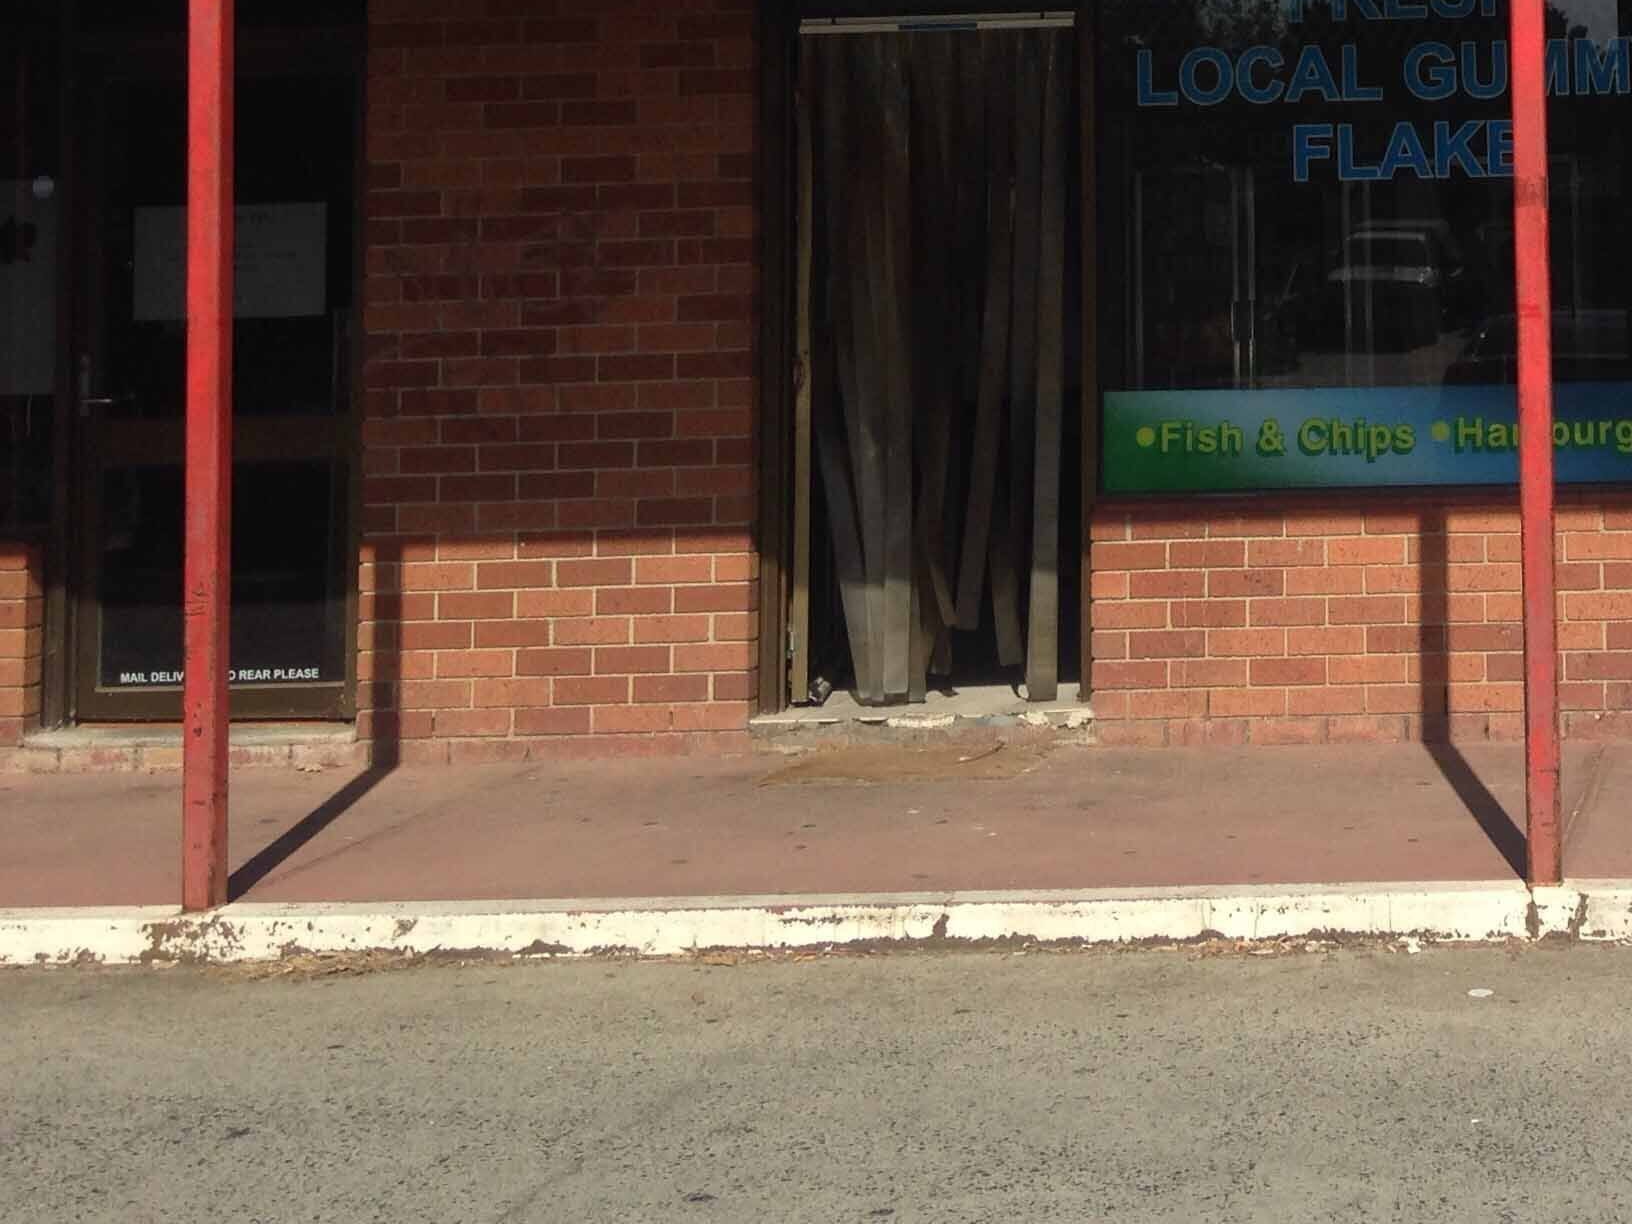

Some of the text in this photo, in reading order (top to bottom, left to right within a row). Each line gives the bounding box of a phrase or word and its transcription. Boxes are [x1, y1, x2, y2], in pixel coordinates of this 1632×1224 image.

[1136, 44, 1384, 107] LOCAL
[1291, 119, 1514, 182] FLAKE
[1160, 419, 1243, 454] Fish
[1256, 418, 1286, 455] &
[1298, 415, 1416, 463] Chips
[120, 672, 148, 683] MAIL
[150, 671, 184, 683] DELIV
[239, 669, 272, 681] REAR
[273, 667, 320, 680] PLEASE
